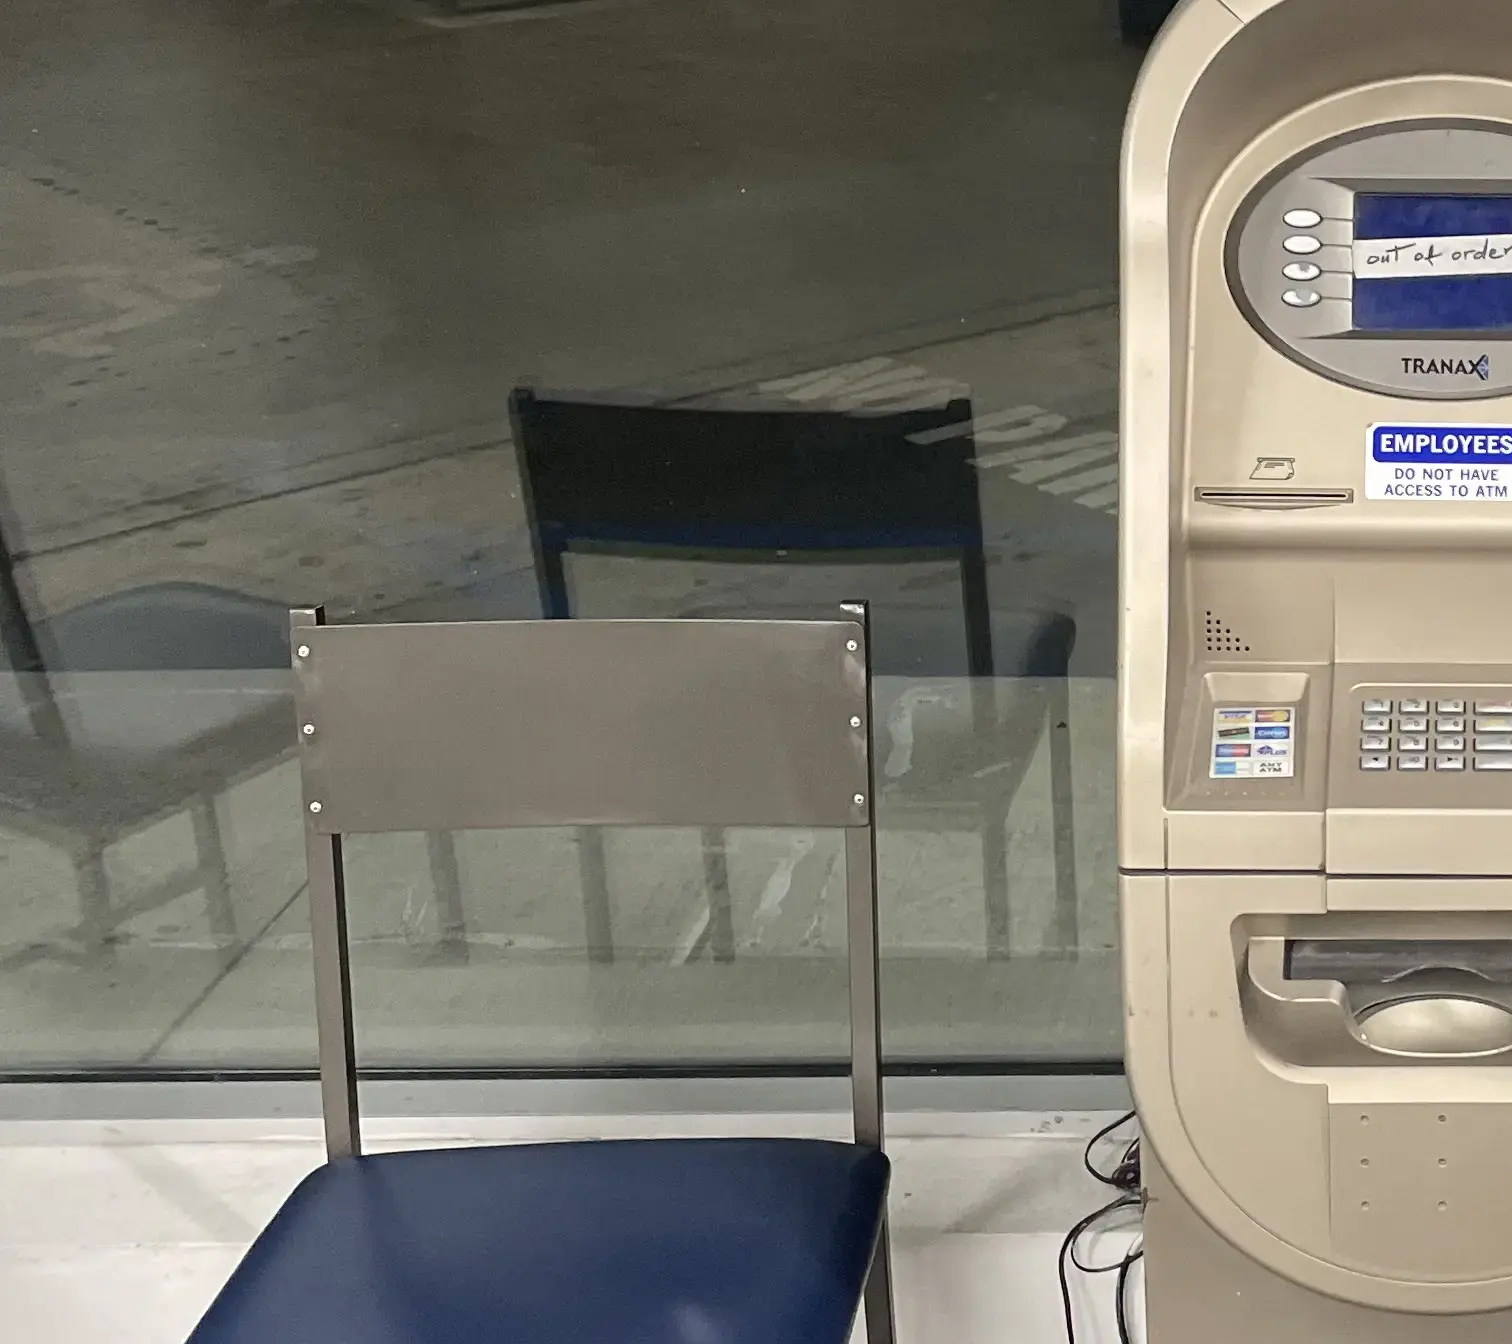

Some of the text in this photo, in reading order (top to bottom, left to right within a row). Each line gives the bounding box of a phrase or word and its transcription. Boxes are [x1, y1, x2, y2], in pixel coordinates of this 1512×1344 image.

[1366, 242, 1417, 265] out
[1413, 243, 1449, 265] of
[1401, 355, 1489, 381] TRANAX
[1395, 468, 1499, 481] DO NOT HAVE
[1384, 484, 1508, 498] ACCESS TO ATM
